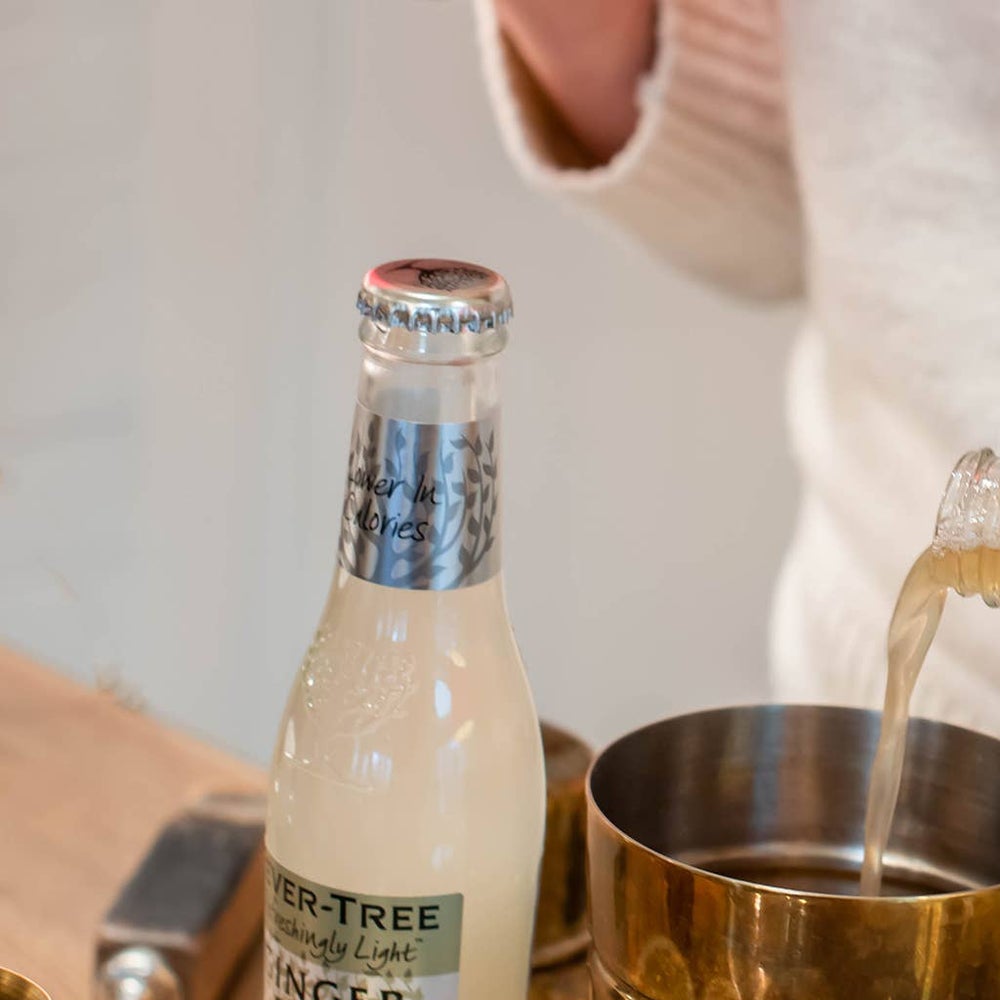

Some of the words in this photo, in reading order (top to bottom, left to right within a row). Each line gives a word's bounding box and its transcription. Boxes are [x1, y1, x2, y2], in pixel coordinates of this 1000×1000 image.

[414, 474, 441, 505] In
[271, 868, 440, 932] VER-TREE
[273, 913, 347, 963] eshingly
